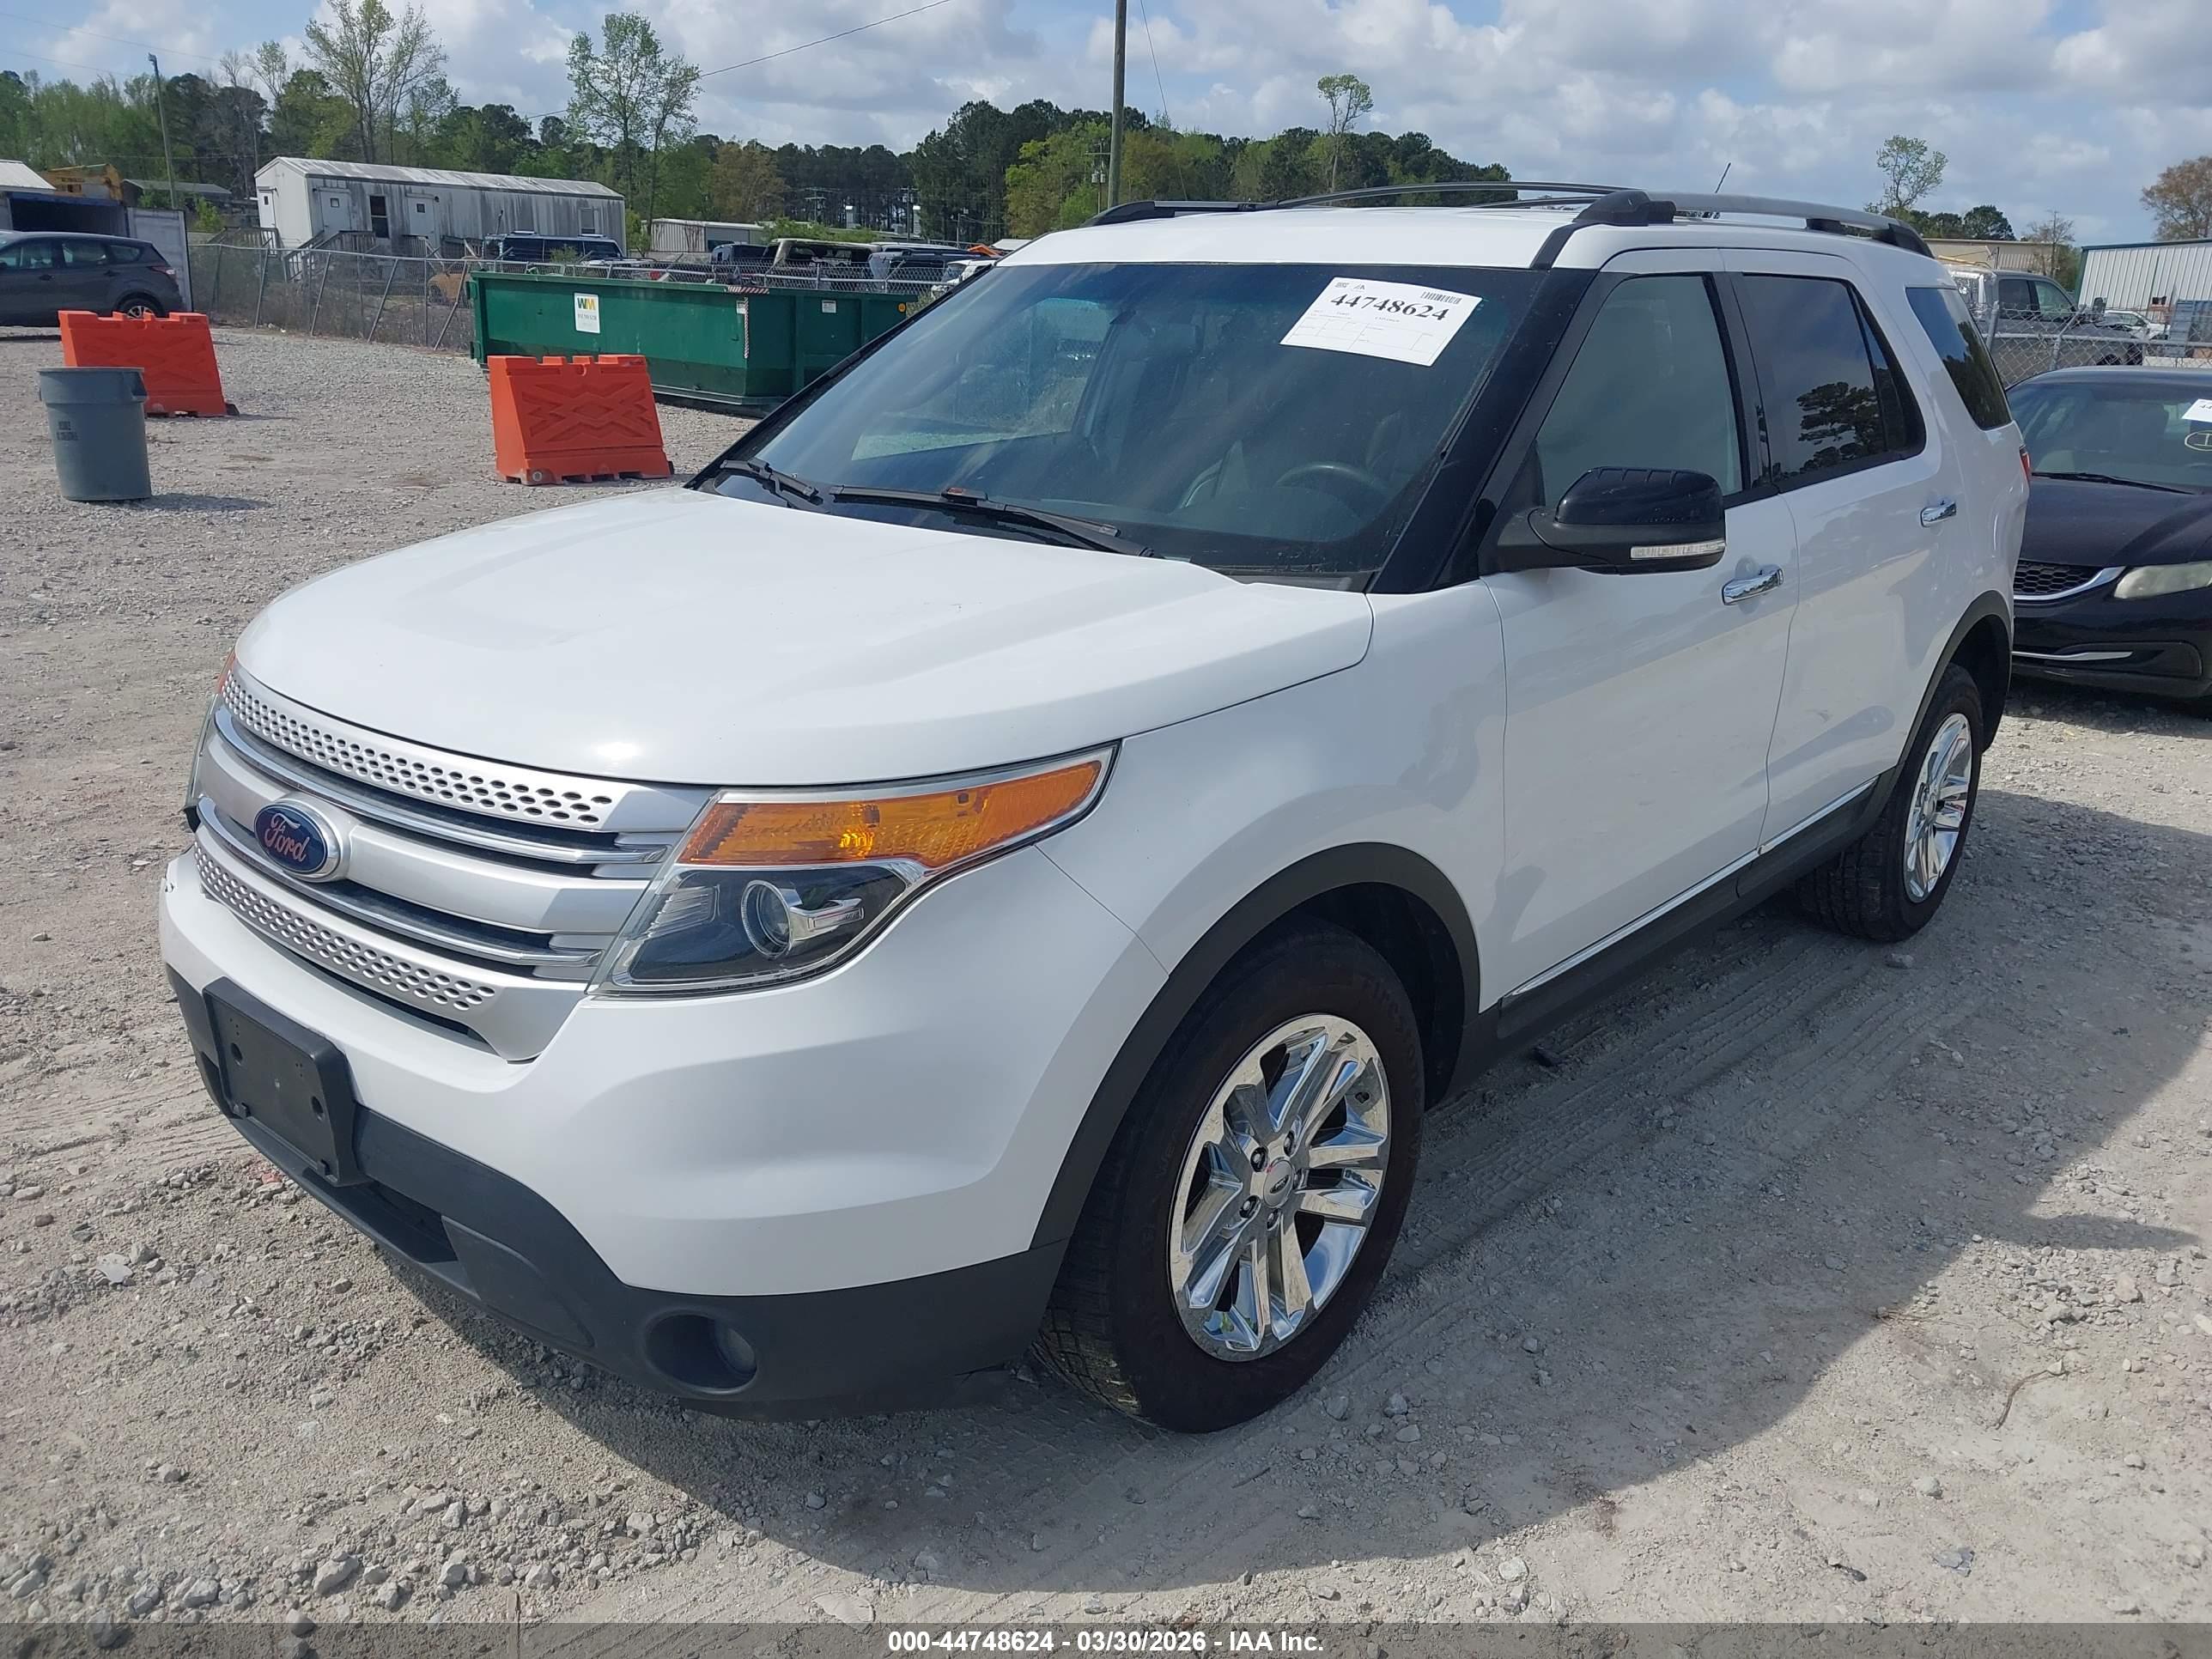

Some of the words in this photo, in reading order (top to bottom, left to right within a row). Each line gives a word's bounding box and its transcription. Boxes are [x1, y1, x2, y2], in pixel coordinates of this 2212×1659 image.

[577, 297, 596, 310] WM
[1330, 294, 1449, 320] 44748624
[264, 812, 310, 862] Ford
